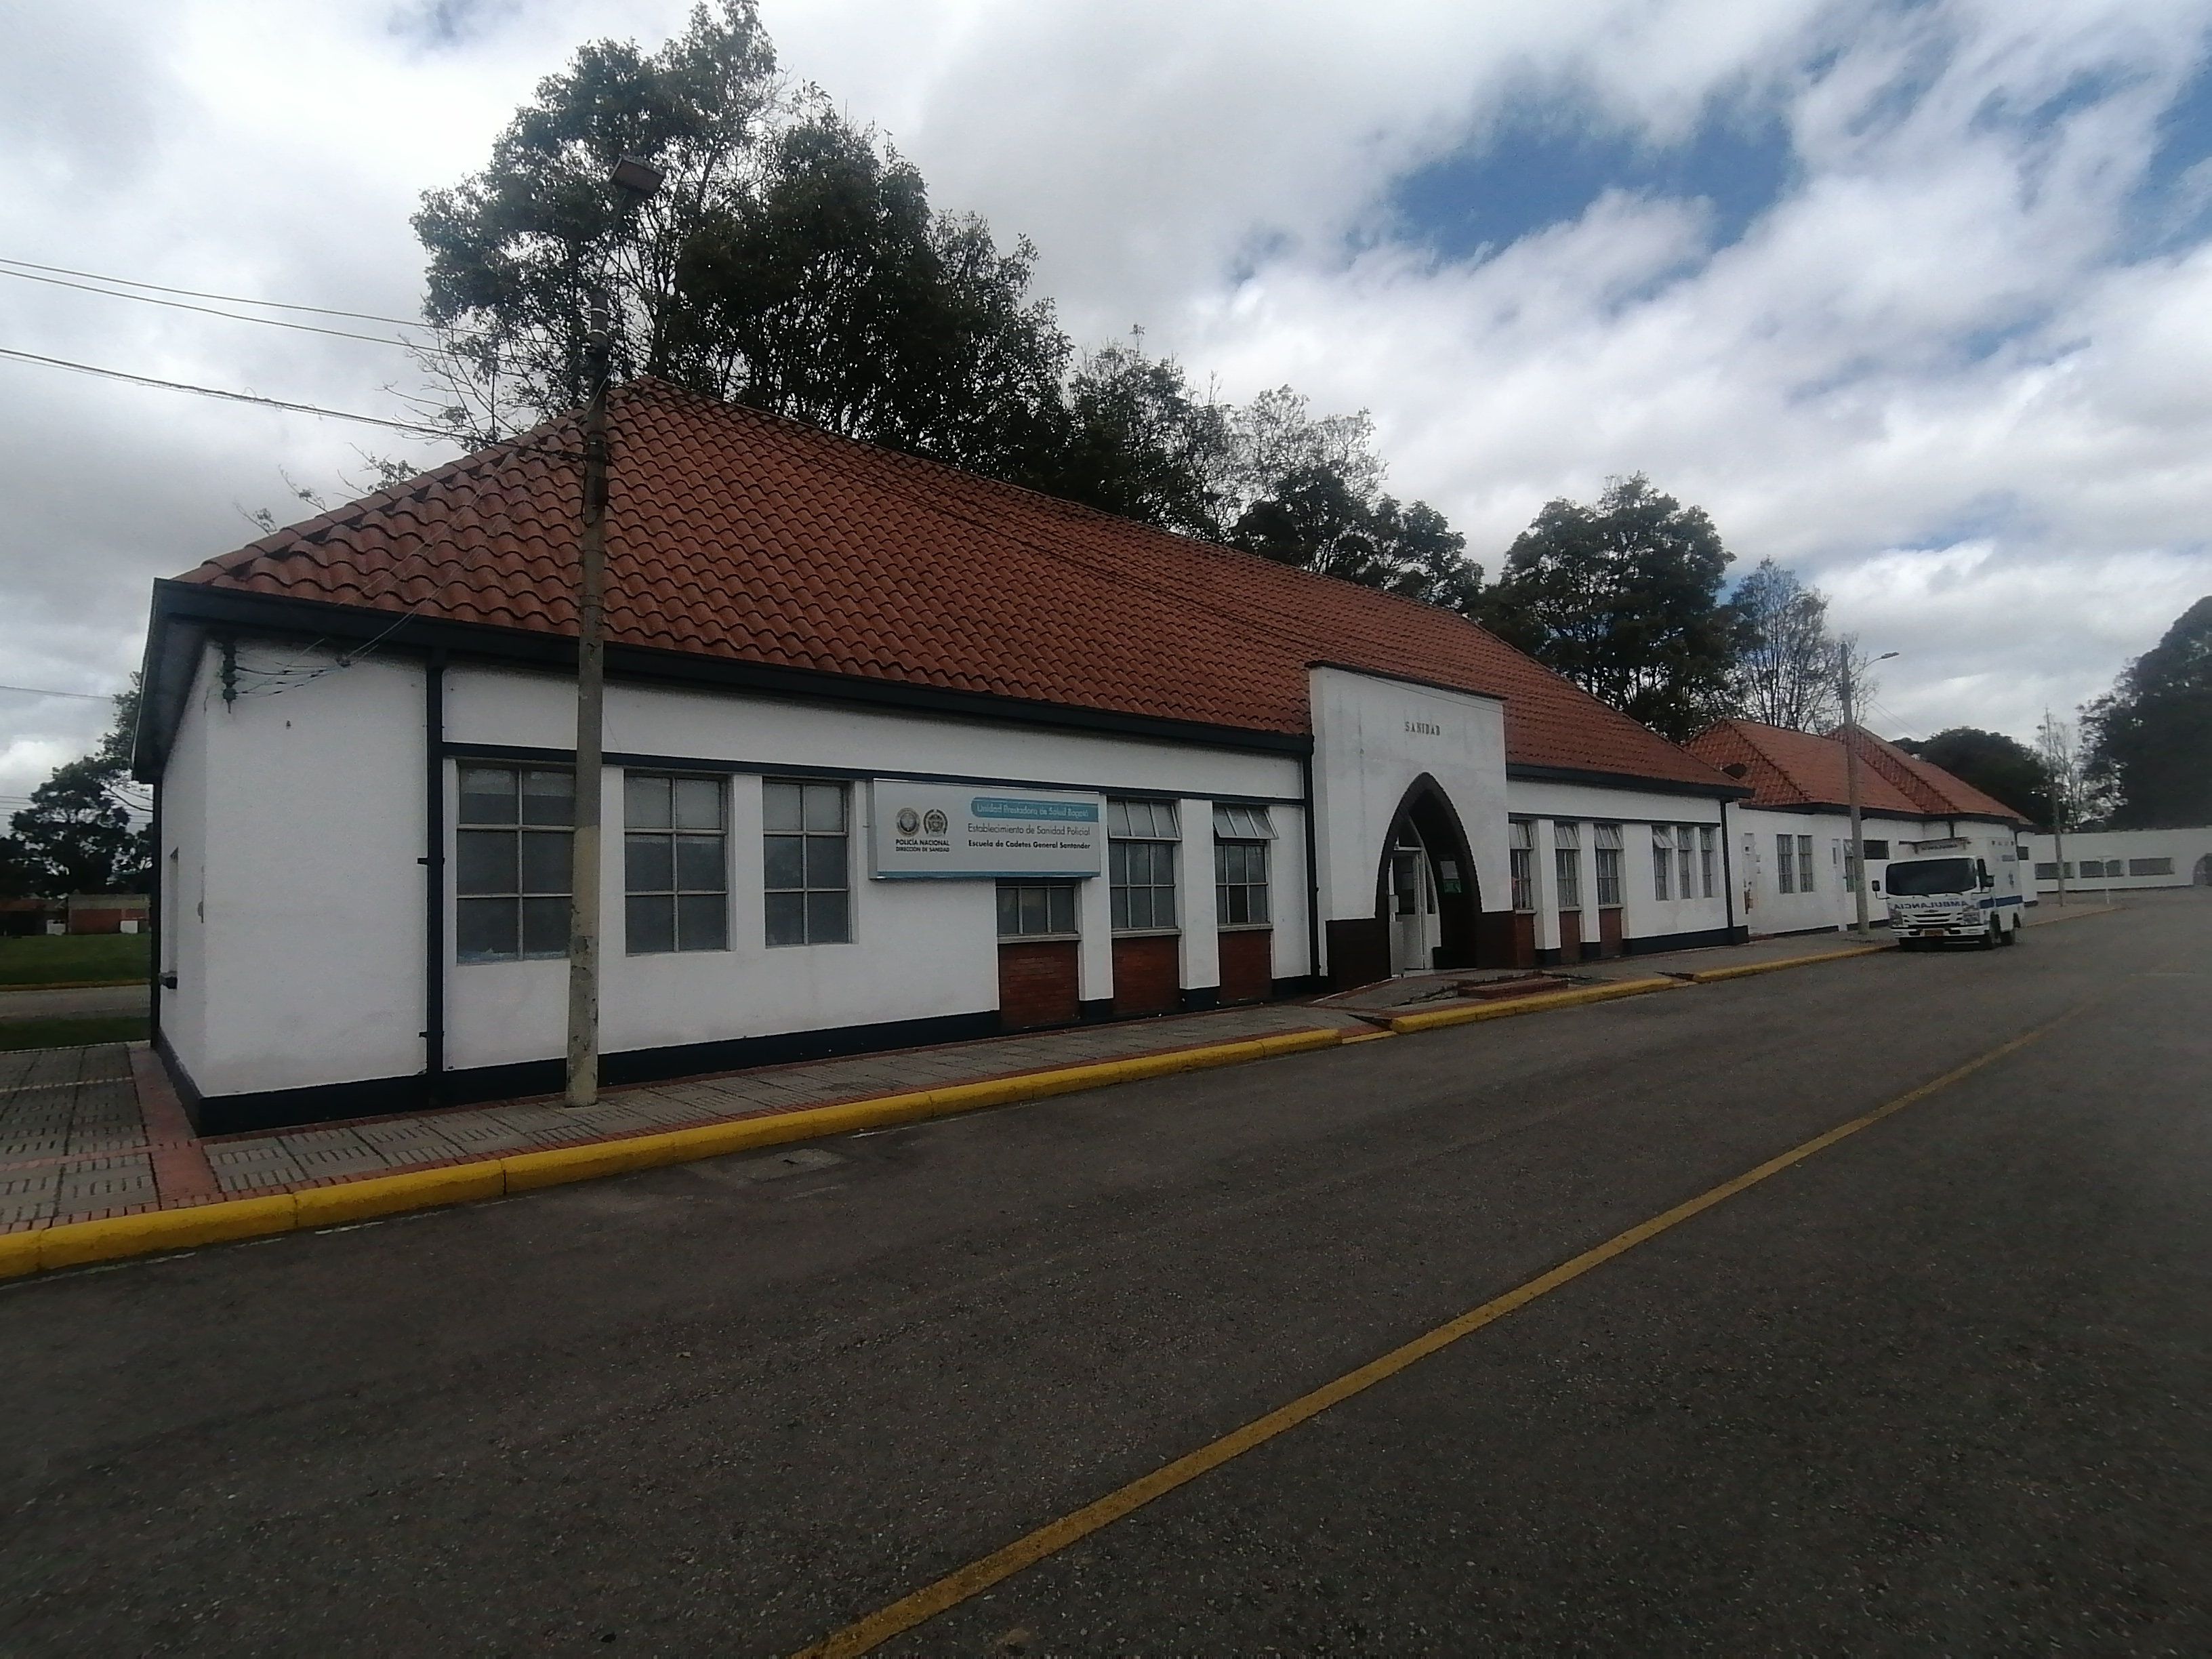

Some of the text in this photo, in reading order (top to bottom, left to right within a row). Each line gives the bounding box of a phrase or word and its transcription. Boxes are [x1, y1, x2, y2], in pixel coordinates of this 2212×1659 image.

[1406, 722, 1440, 736] SANIDAD
[977, 803, 1002, 813] Unidad
[1004, 804, 1037, 815] Prestadora
[1040, 806, 1047, 815] de
[1049, 806, 1066, 816] Salud
[968, 823, 1090, 836] Establecimiento de Sanidad Policial
